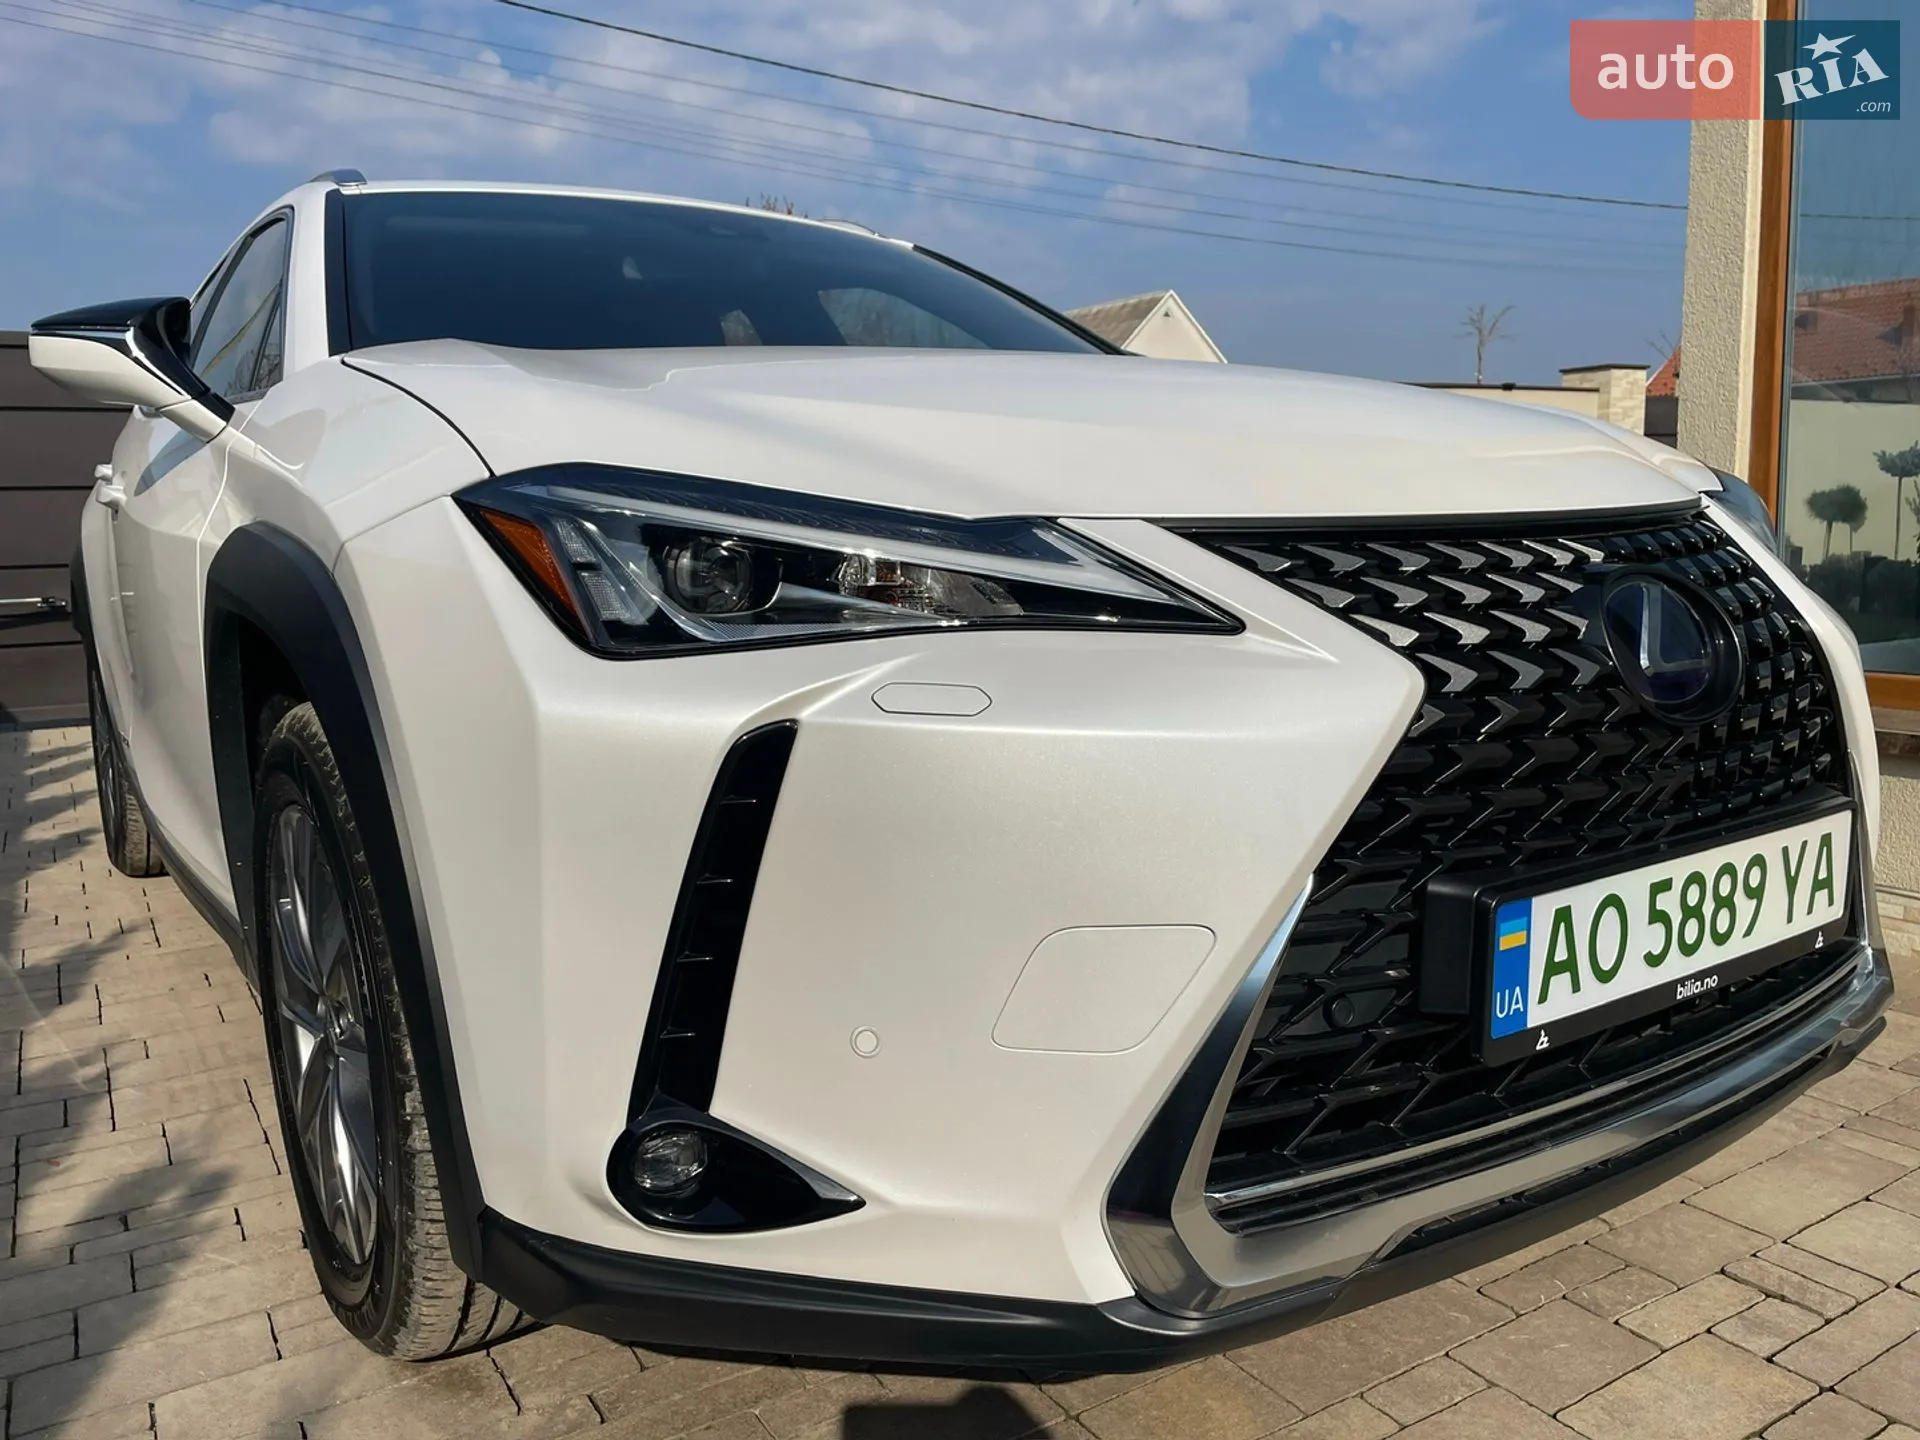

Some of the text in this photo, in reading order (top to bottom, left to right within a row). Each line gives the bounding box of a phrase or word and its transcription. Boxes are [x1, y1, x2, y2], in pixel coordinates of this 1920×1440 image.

[1537, 832, 1835, 1005] AO 5889 YA
[1495, 986, 1524, 1018] UA
[1676, 975, 1719, 1000] bilia.no
